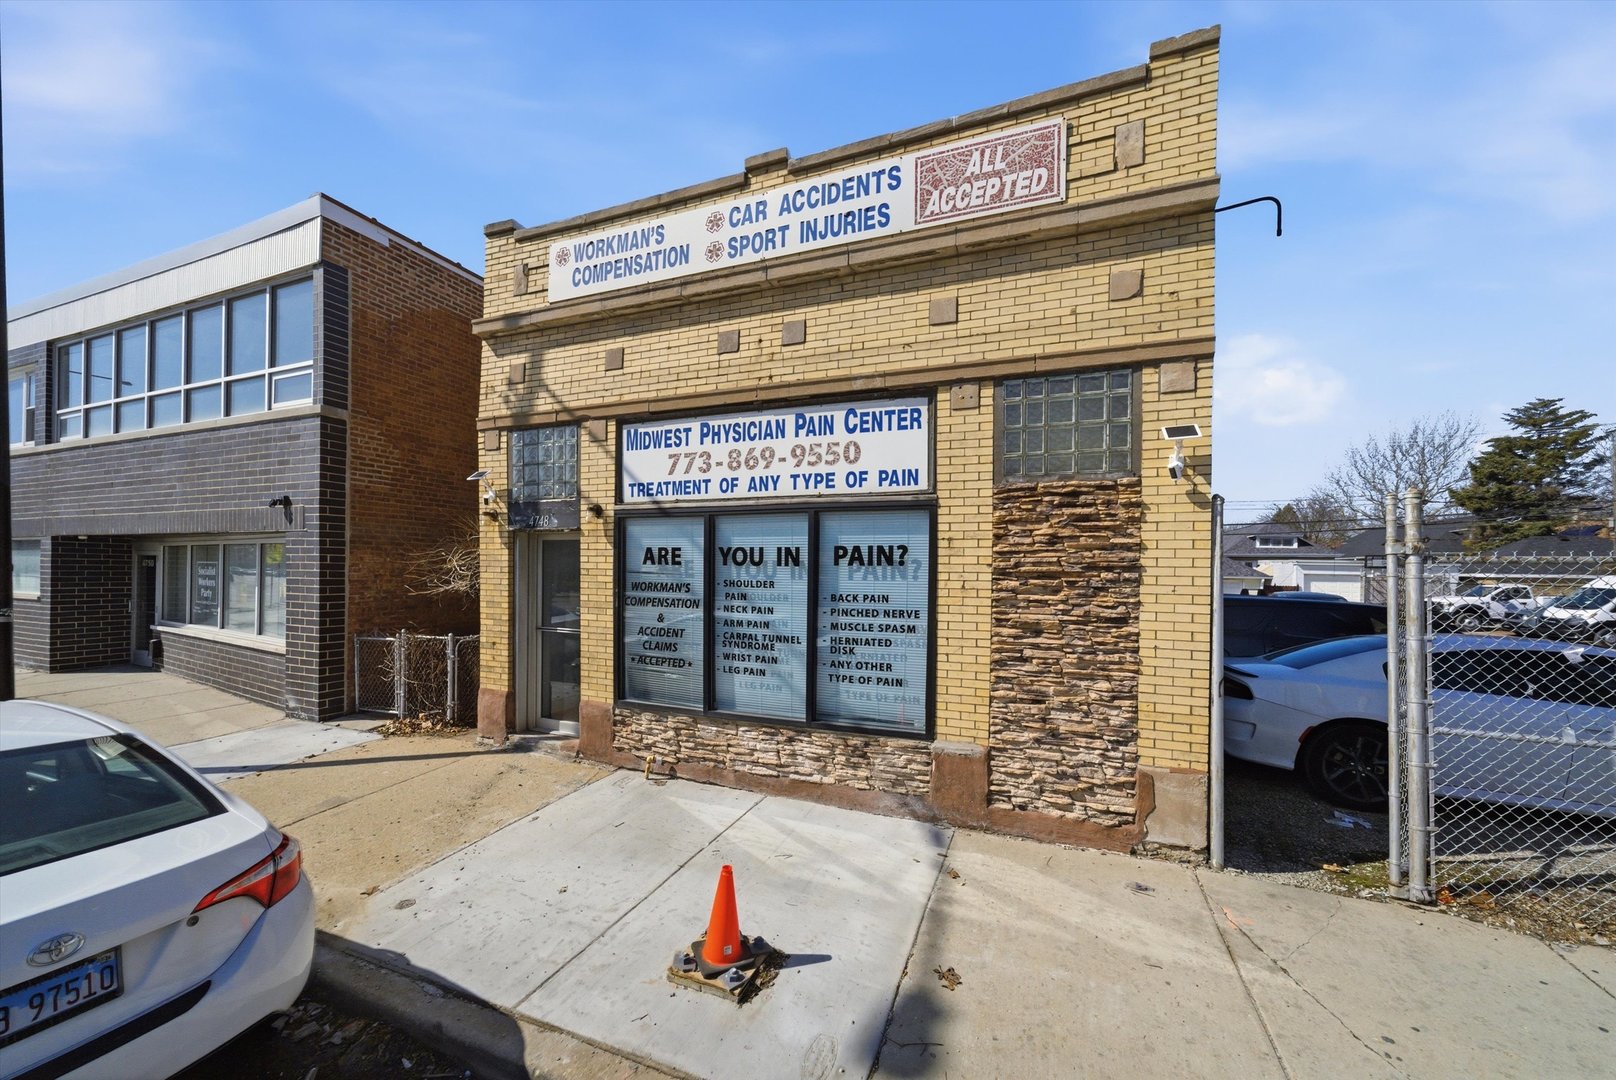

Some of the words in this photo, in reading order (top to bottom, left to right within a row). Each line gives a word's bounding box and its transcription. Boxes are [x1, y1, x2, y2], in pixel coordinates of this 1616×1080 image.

[966, 145, 1006, 176] ALL
[728, 200, 768, 228] CAR
[778, 166, 901, 216] ACCIDENTS
[925, 167, 1048, 216] ACCEPTED
[728, 226, 789, 259] SPORT
[800, 203, 890, 244] INJURIES
[574, 224, 665, 263] WORKMAN'S
[572, 244, 690, 288] COMPENSATION
[627, 427, 691, 451] MIDWEST
[700, 418, 785, 445] PHYSICIAN
[795, 412, 834, 438] PAIN
[844, 408, 922, 434] CENTER
[668, 440, 861, 475] 773-869-9550
[629, 479, 711, 496] TREATMENT
[719, 478, 739, 494] OF
[748, 475, 780, 492] ANY
[790, 473, 835, 490] TYPE
[846, 471, 868, 488] OF
[878, 469, 919, 487] PAIN
[642, 547, 682, 565] ARE
[718, 547, 764, 566] YOU
[776, 547, 800, 566] IN
[833, 545, 909, 567] PAIN?
[631, 582, 690, 593] WORKMAN'S
[723, 580, 775, 588] SHOULDER
[201, 588, 212, 600] Party
[725, 592, 747, 600] PAIN
[830, 594, 858, 603] BACK
[863, 594, 889, 604] PAIN
[625, 596, 700, 609] COMPENSATION
[723, 605, 748, 614] NECK
[751, 606, 774, 615] PAIN
[830, 608, 879, 618] PINCHED
[883, 609, 920, 619] NERVE
[657, 614, 664, 623] &
[723, 619, 744, 628] ARM
[747, 620, 770, 629] PAIN
[638, 627, 685, 638] ACCIDENT
[830, 623, 874, 632] MUSCLE
[878, 624, 916, 634] SPASM
[723, 632, 759, 642] CARPAL
[762, 634, 801, 645] TUNNEL
[830, 637, 892, 648] HERNIATED
[643, 641, 678, 652] CLAIMS
[722, 640, 775, 651] SYNDROME
[830, 646, 855, 656] DISK
[637, 656, 685, 668] ACCEPTED
[723, 653, 752, 663] WRIST
[755, 655, 778, 665] PAIN
[723, 666, 740, 675] LEG
[744, 668, 766, 677] PAIN
[830, 660, 852, 670] ANY
[855, 661, 892, 672] OTHER
[828, 674, 854, 684] TYPE
[858, 675, 872, 685] OF
[876, 677, 903, 687] PAIN
[28, 965, 114, 1022] 97510
